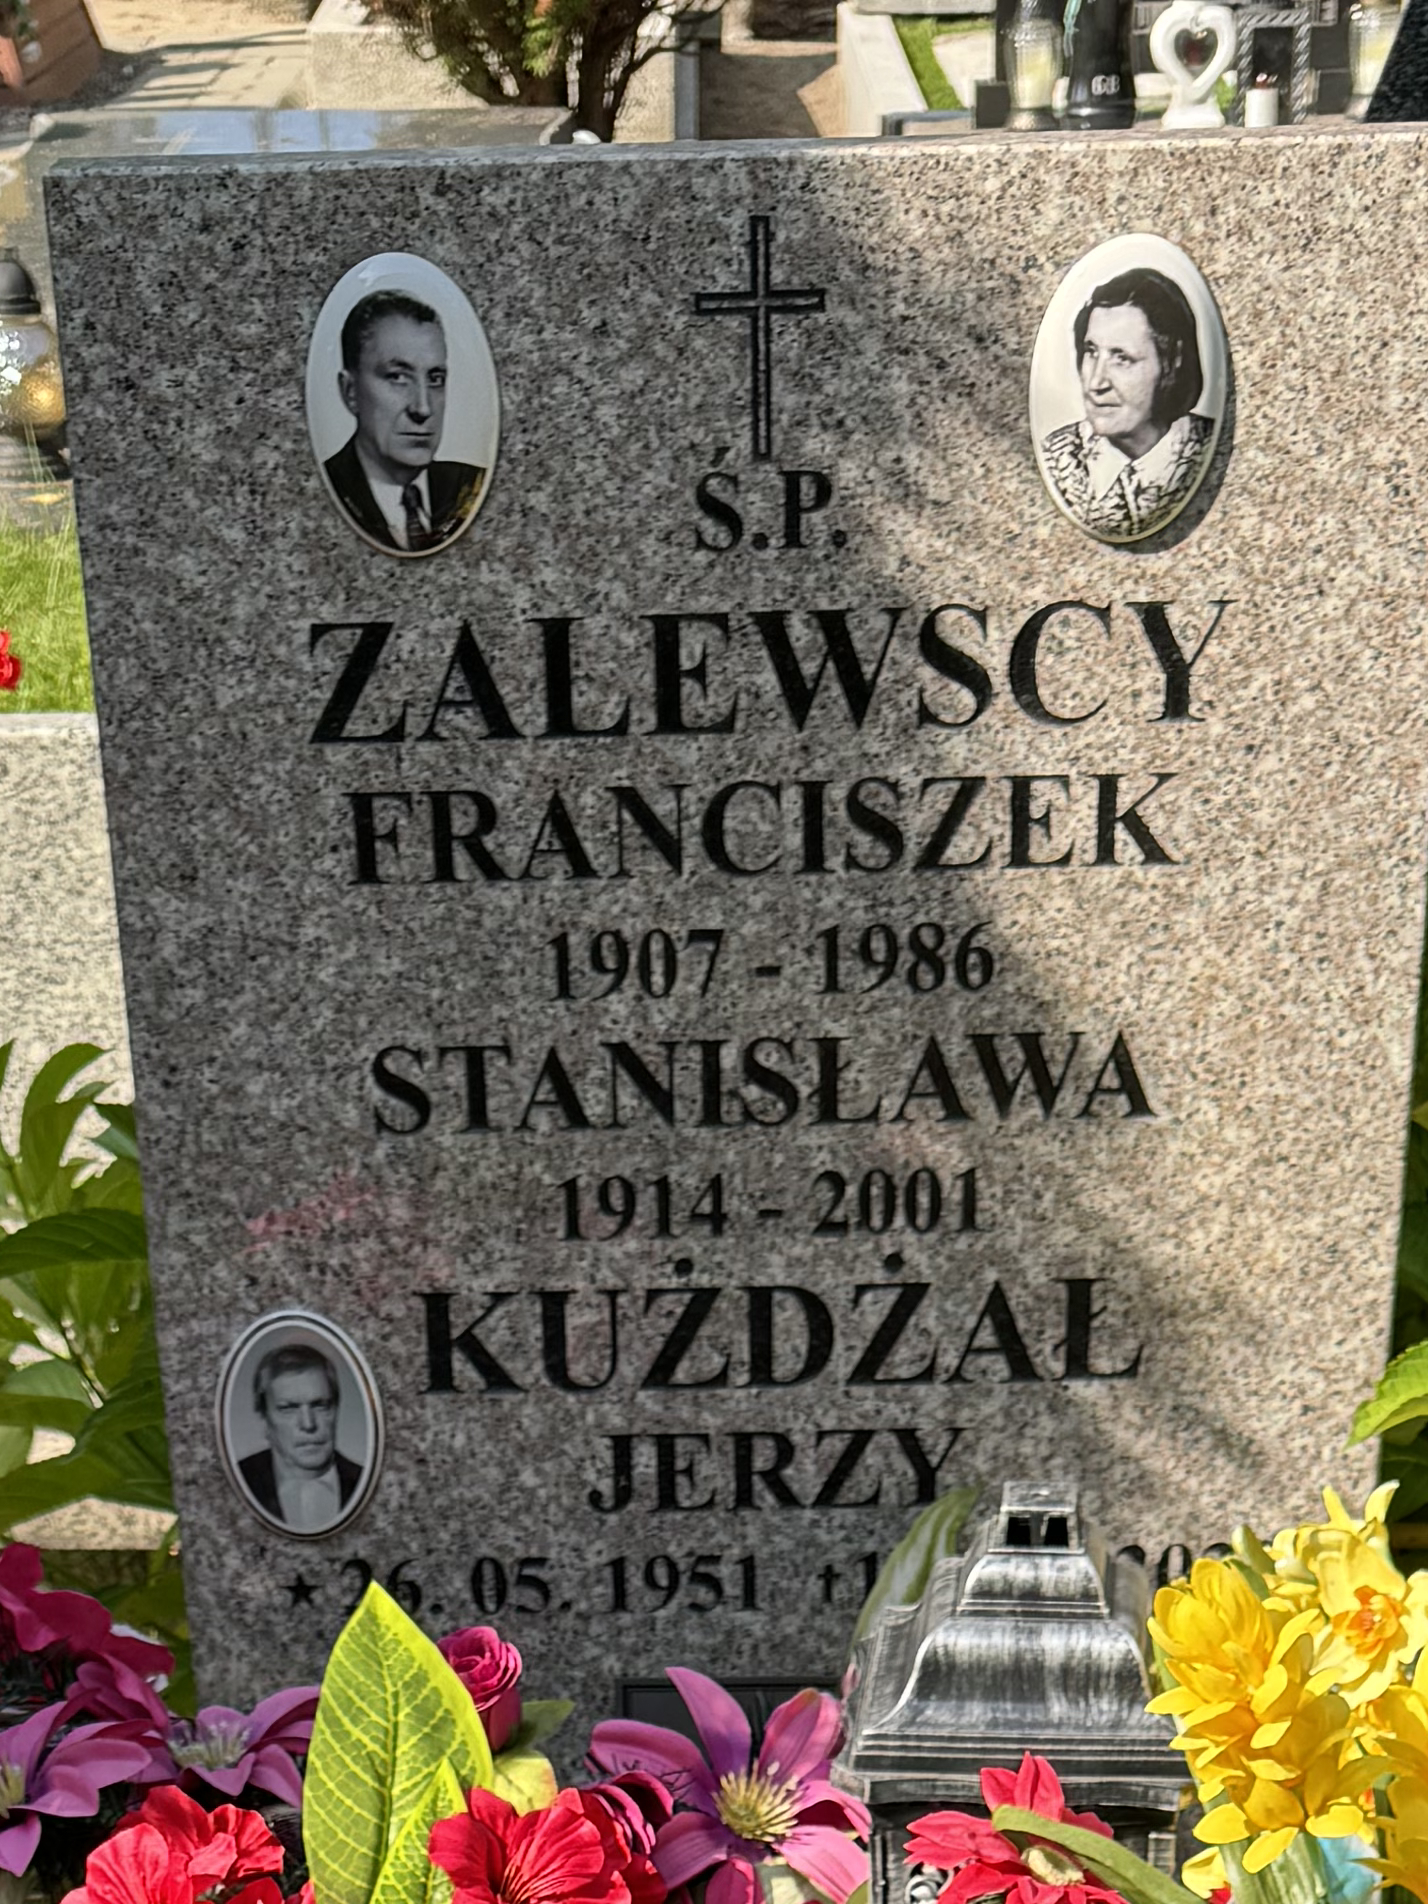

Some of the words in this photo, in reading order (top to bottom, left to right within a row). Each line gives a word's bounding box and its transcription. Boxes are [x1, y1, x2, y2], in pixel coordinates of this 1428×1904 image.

[692, 446, 850, 556] Ś.P.
[306, 598, 1232, 747] ZALEWSCY
[343, 771, 1180, 887] FRANCISZEK
[546, 926, 727, 1002] 1907
[816, 920, 997, 996] 1986
[372, 1028, 1156, 1137] STANISŁAWA
[556, 1172, 732, 1243] 1914
[812, 1165, 982, 1238] 2001
[415, 1250, 1145, 1396] KUŻDŻAŁ
[586, 1423, 966, 1515] JERZY
[603, 1552, 764, 1615] 1951
